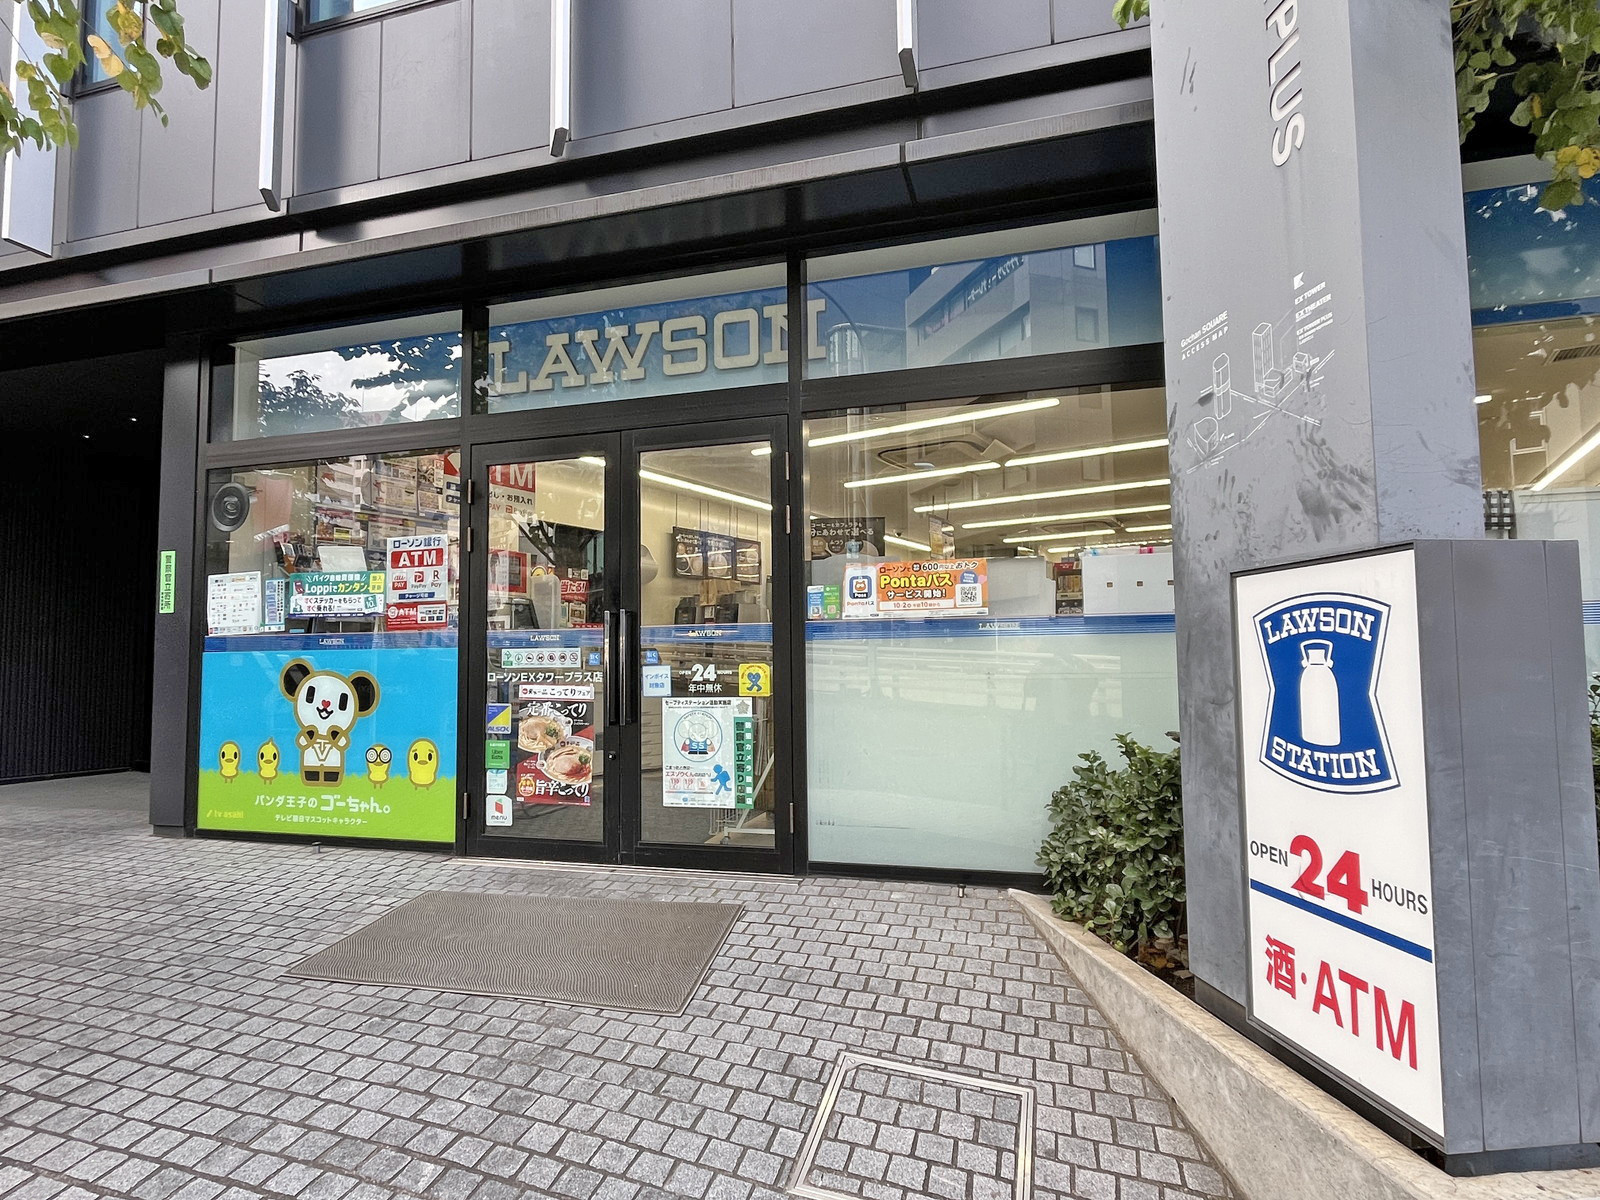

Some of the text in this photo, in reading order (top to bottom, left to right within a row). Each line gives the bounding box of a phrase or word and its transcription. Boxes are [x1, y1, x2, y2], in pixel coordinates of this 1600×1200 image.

[1264, 0, 1305, 167] PLUS
[1201, 310, 1229, 334] SQUARE
[488, 299, 826, 394] LAWSON
[1181, 326, 1228, 360] ACCESS MAP
[393, 536, 441, 548] ローソン銀行
[398, 550, 436, 567] ATM
[880, 573, 953, 589] Pontaパス
[399, 607, 416, 616] ATM
[1264, 607, 1375, 644] LAWSON
[487, 671, 603, 682] ローソンEXタワープラス店
[691, 663, 717, 681] 24
[688, 684, 722, 693] 年中無休
[1271, 735, 1381, 779] STATION
[255, 794, 391, 815] パンダ王子の ゴーちゃん。
[1250, 834, 1428, 915] OPEN 24 HOURS
